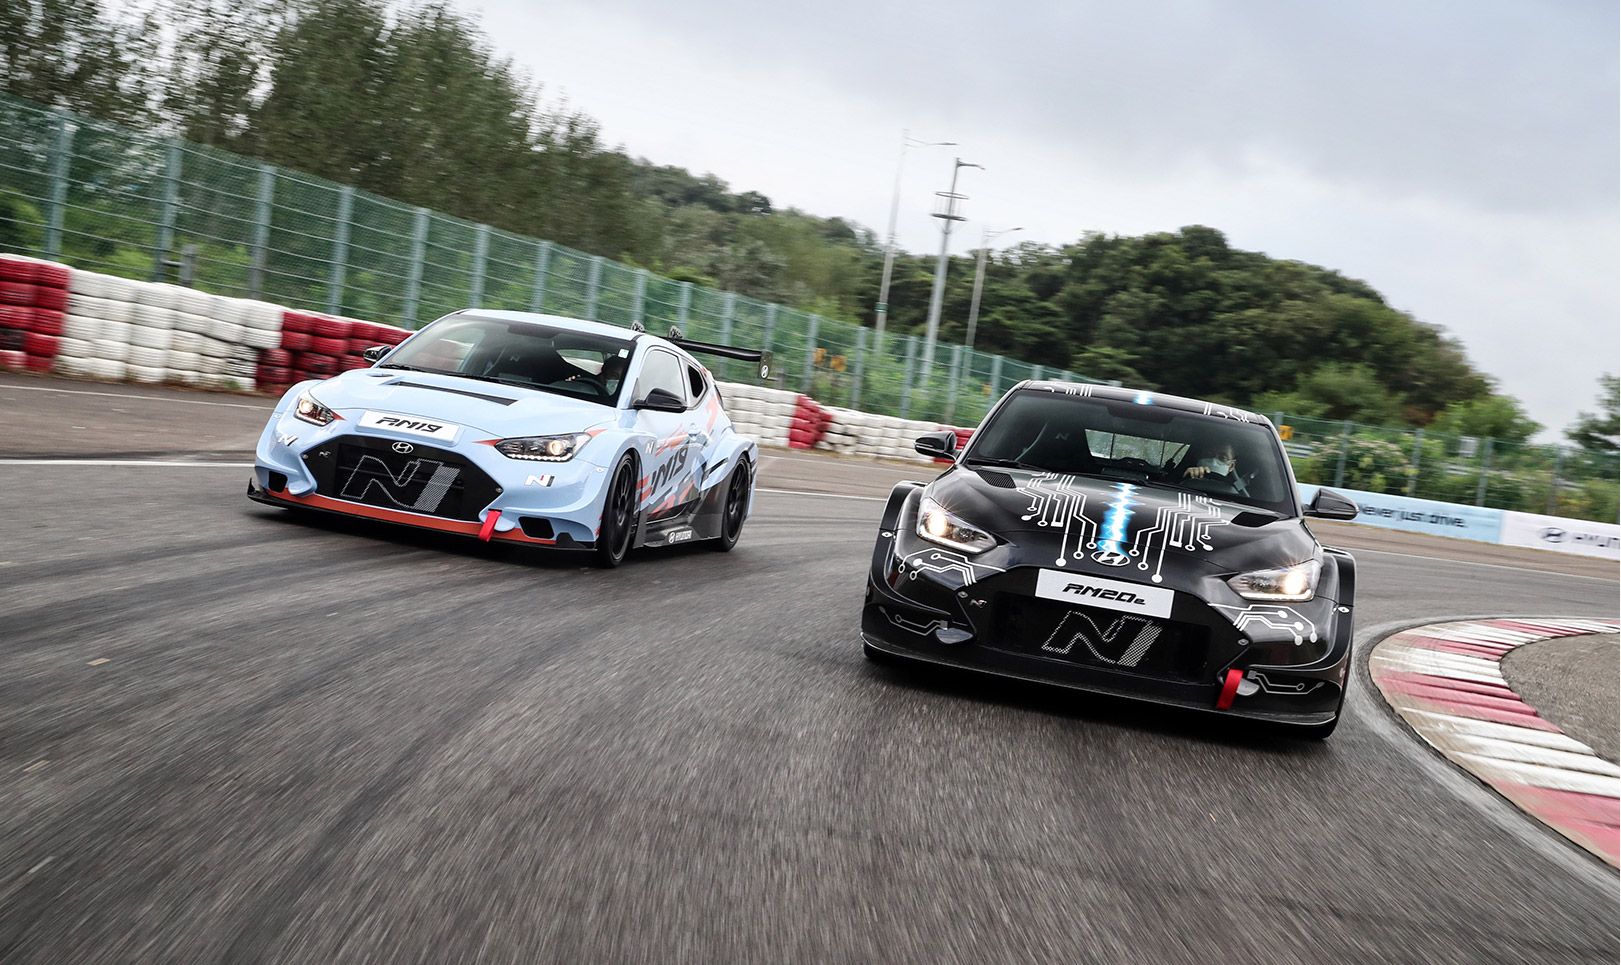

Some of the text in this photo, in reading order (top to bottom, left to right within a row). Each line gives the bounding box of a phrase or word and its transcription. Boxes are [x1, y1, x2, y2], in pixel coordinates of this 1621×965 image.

[376, 416, 443, 433] RM19
[340, 454, 461, 513] N
[523, 474, 556, 488] N
[1041, 609, 1163, 668] N
